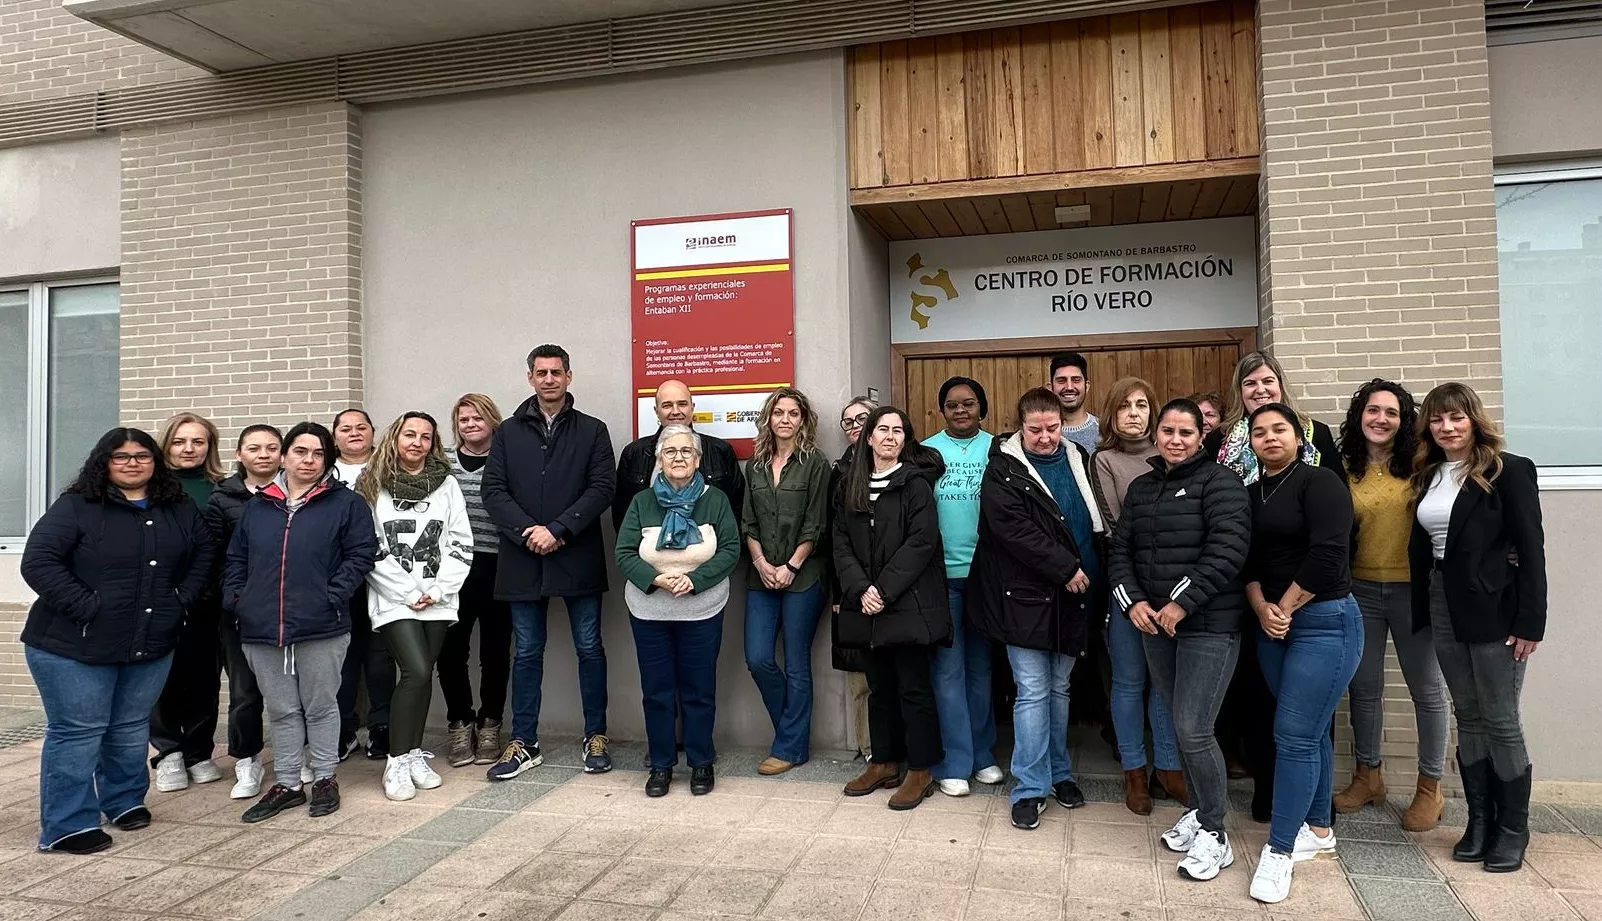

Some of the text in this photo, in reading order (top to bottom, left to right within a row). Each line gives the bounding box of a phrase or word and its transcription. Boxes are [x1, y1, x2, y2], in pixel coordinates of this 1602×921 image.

[698, 235, 736, 245] inaem
[1006, 254, 1049, 264] COMARCA
[1066, 248, 1122, 260] SOMONTANO
[1126, 248, 1138, 256] DE
[1140, 244, 1196, 254] BARBASTRO
[974, 254, 1233, 291] CENTRO DE FORMACIÓN
[644, 280, 746, 294] Programas experienciales
[644, 291, 738, 304] de empleo y formación:
[1052, 290, 1152, 312] RÍO VERO
[645, 306, 676, 315] Entaban
[940, 474, 966, 490] Great
